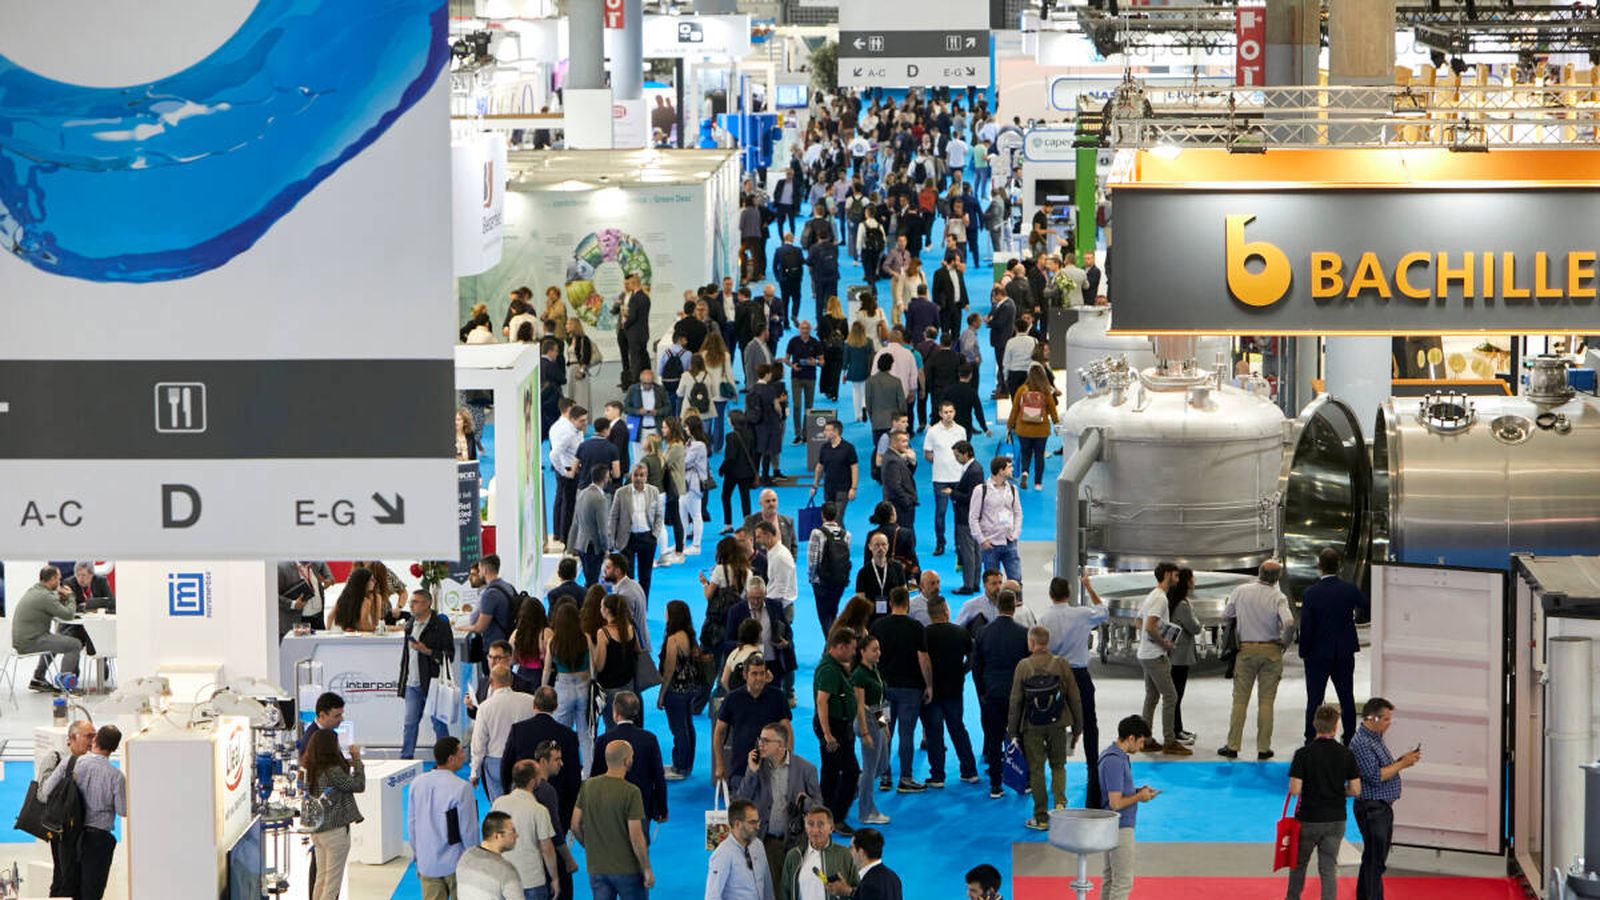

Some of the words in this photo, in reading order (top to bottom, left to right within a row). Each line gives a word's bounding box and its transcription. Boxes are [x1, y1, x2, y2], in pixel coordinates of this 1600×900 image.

[868, 68, 886, 77] A-C
[907, 64, 919, 77] D
[944, 68, 962, 77] E-G
[1311, 251, 1597, 299] BACHILLE
[21, 500, 83, 527] A-C
[161, 484, 202, 529] D
[295, 500, 355, 526] E-G
